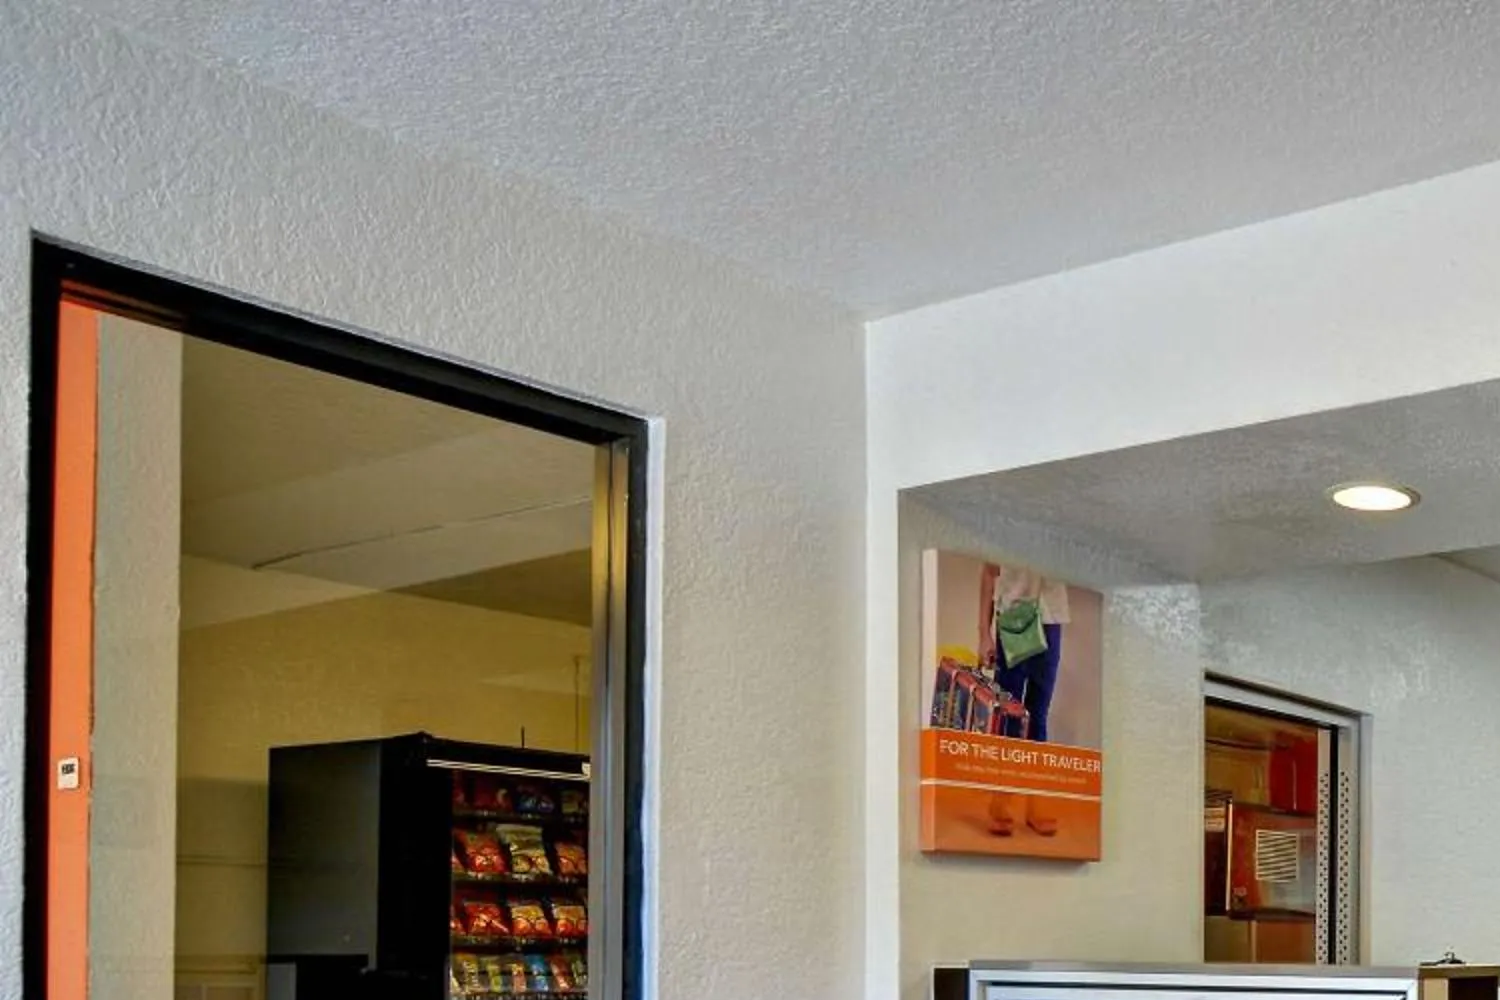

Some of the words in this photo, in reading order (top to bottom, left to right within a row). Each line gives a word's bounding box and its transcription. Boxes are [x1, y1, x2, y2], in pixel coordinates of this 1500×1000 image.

[939, 739, 969, 756] FOR
[972, 744, 999, 761] THE
[1001, 748, 1040, 766] LIGHT
[1041, 752, 1101, 773] TRAVELER
